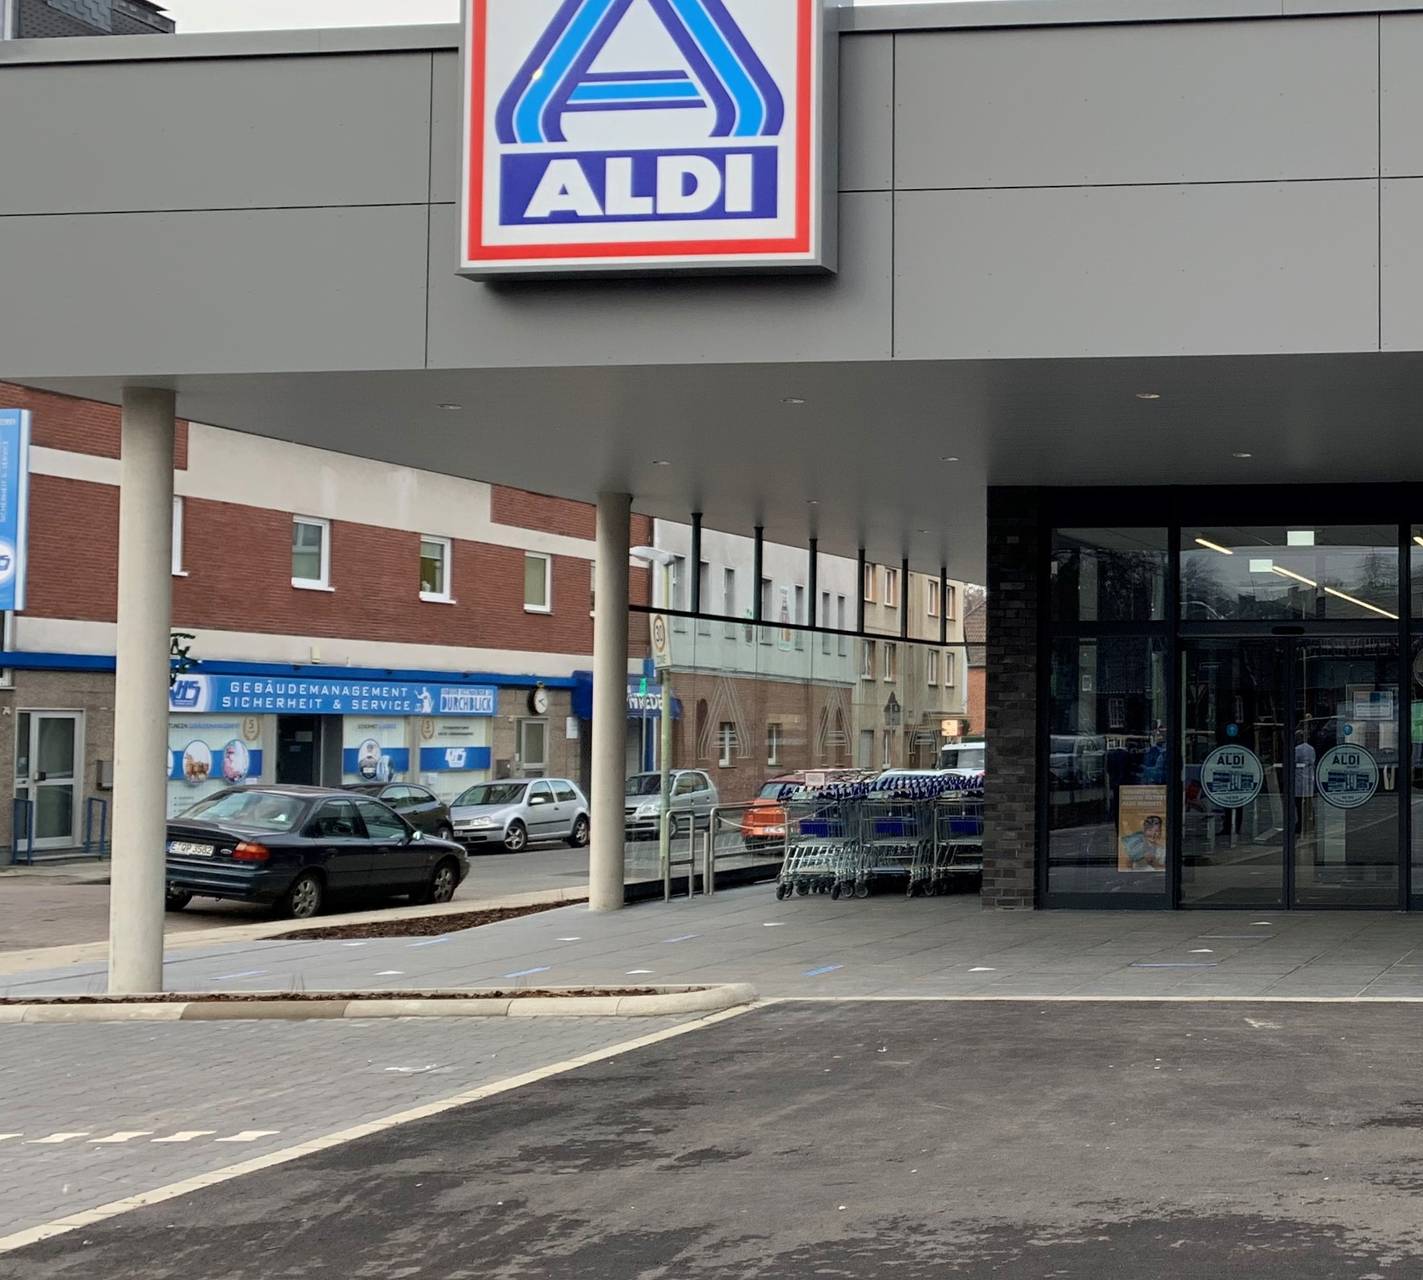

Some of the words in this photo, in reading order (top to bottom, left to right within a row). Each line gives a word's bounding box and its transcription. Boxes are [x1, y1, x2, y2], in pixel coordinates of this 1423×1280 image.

[523, 154, 753, 218] ALDI
[230, 680, 408, 698] GEBÄUDEMANAGEMENT
[222, 696, 322, 709] SICHERHEIT
[333, 699, 342, 710] &
[351, 699, 410, 711] SERVICE
[1217, 755, 1245, 765] ALDI
[1332, 754, 1360, 765] ALDI
